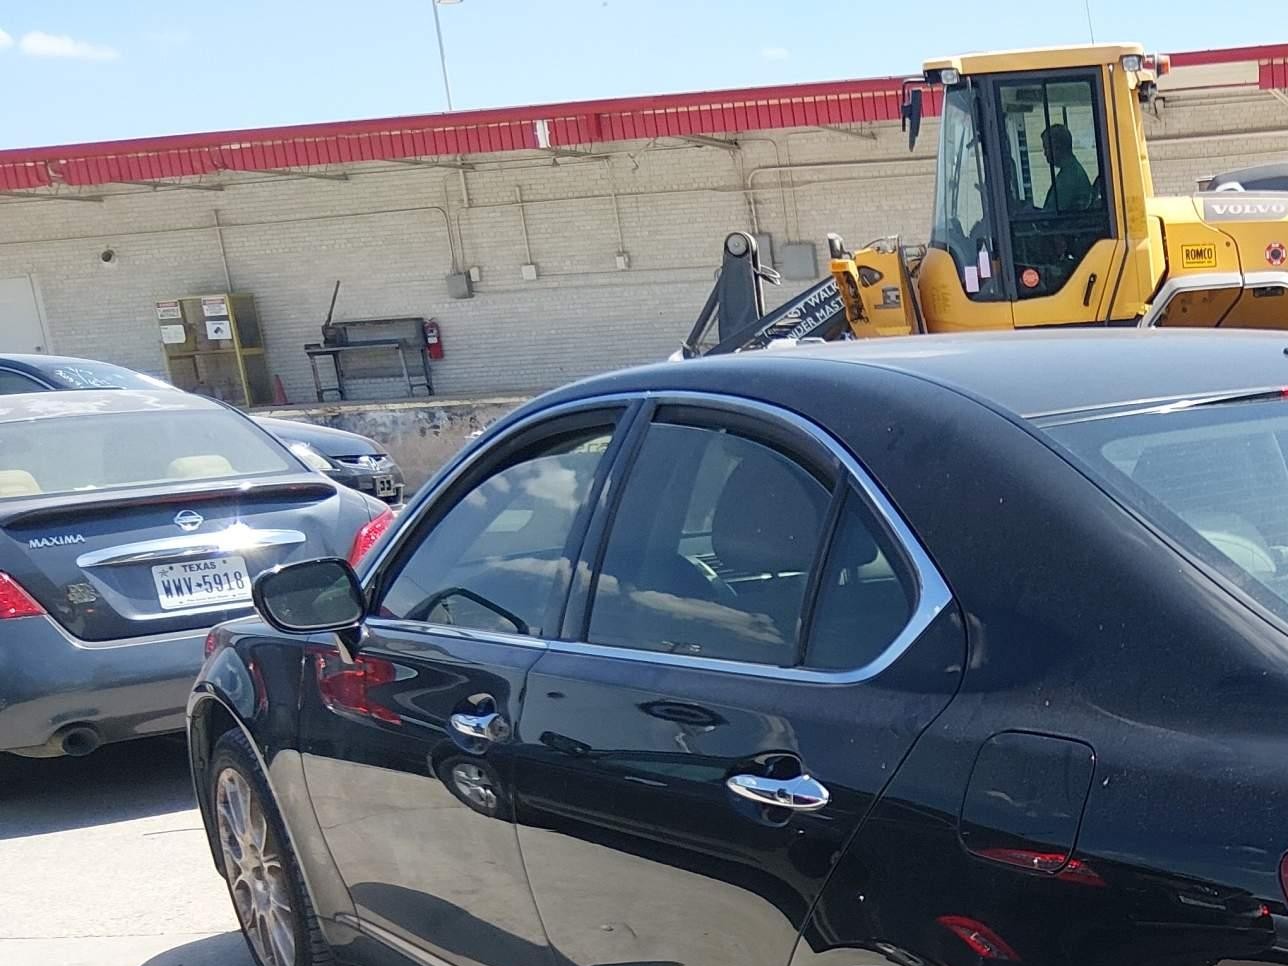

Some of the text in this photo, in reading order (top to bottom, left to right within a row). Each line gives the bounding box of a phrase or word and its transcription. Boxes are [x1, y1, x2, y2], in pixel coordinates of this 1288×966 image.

[1211, 204, 1285, 215] VOLVO
[1185, 247, 1213, 261] ROMCO
[807, 280, 841, 308] WALK
[815, 297, 845, 321] MAST
[29, 533, 86, 549] MAXIMA
[181, 561, 217, 573] TEXAS
